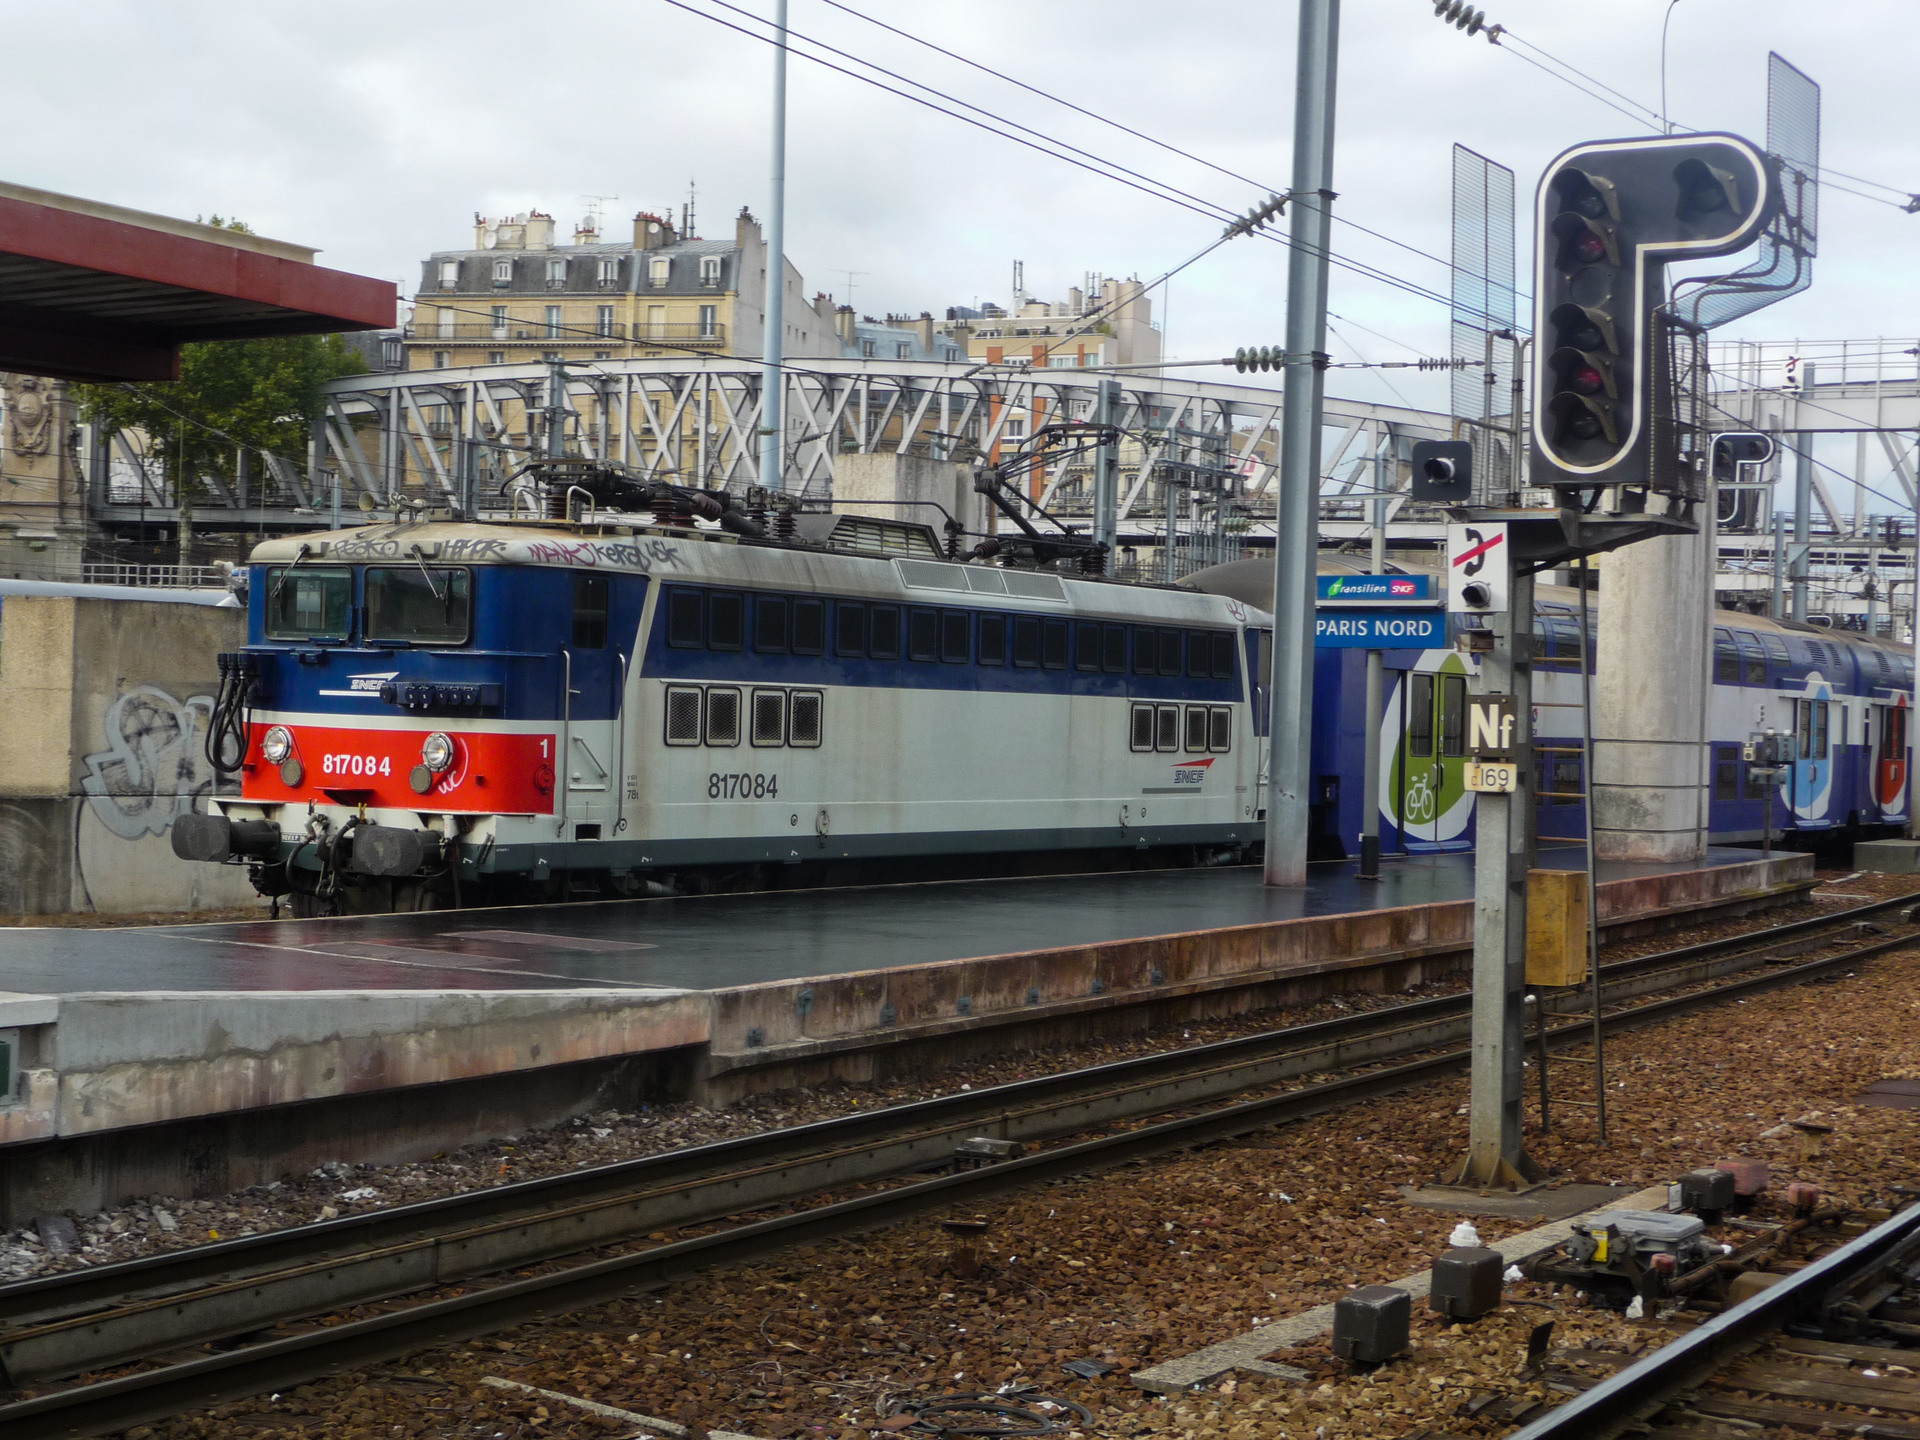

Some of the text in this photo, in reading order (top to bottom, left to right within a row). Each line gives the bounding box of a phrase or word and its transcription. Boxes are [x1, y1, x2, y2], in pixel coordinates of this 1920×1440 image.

[1333, 584, 1415, 594] Transilien SNCF
[1316, 620, 1433, 636] PARIS NORD
[1470, 703, 1515, 748] Nf
[540, 739, 548, 758] 1
[323, 753, 391, 776] 817084
[708, 773, 778, 799] 817084
[1174, 770, 1204, 784] SNCF
